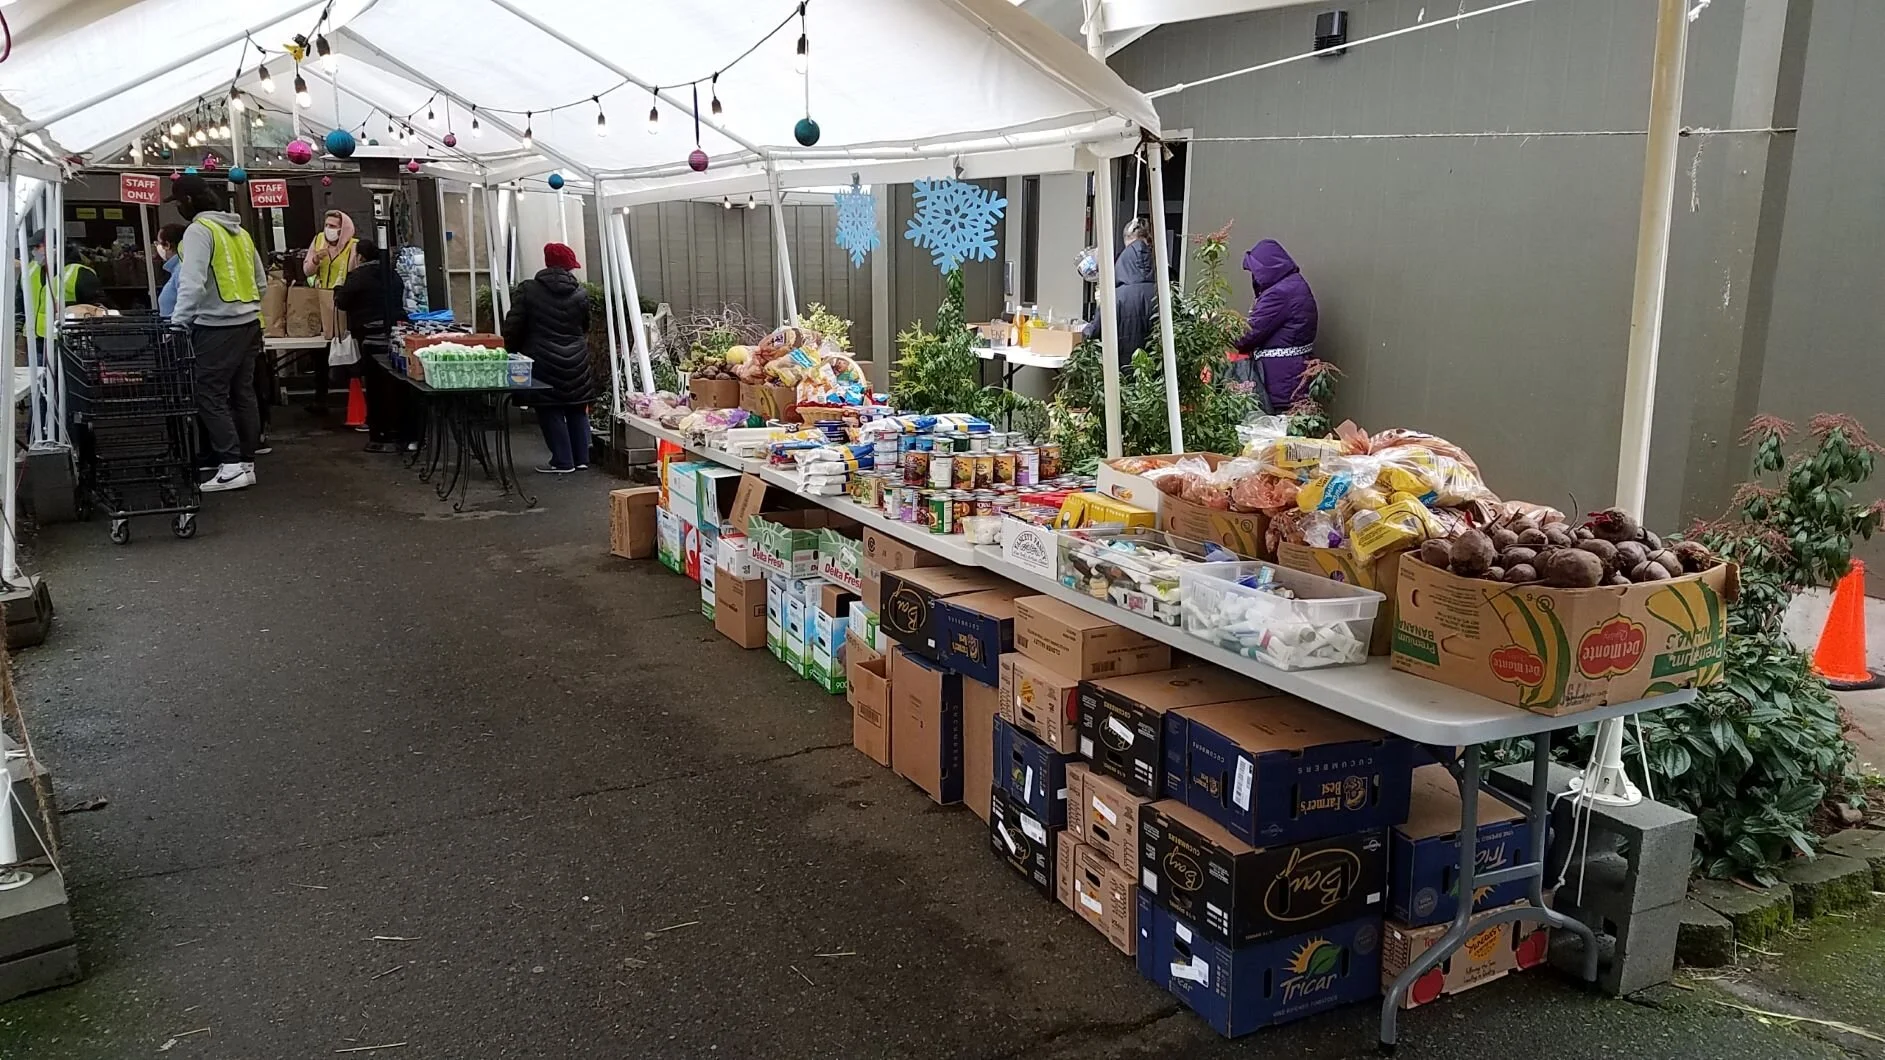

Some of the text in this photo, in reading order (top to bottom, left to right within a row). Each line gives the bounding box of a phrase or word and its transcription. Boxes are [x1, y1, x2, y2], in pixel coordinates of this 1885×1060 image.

[126, 178, 156, 188] STAFF
[254, 184, 282, 192] STAFF
[127, 190, 155, 200] ONLY
[258, 194, 282, 203] ONLY
[752, 548, 767, 562] Delta
[767, 554, 785, 569] Fresh
[824, 563, 843, 580] Delta
[1397, 632, 1436, 654] Premium
[1582, 639, 1641, 662] Del Monte
[1493, 657, 1541, 677] Del Monte
[1192, 740, 1225, 763] CUCUMBERS
[1297, 757, 1373, 775] CUCUMBERS
[1320, 780, 1342, 797] Best
[1300, 795, 1341, 815] Farmer's
[1167, 832, 1201, 857] CUCUMBERS
[1169, 845, 1198, 890] Bay
[1276, 847, 1349, 905] Bay
[1280, 973, 1338, 1005] Tricar
